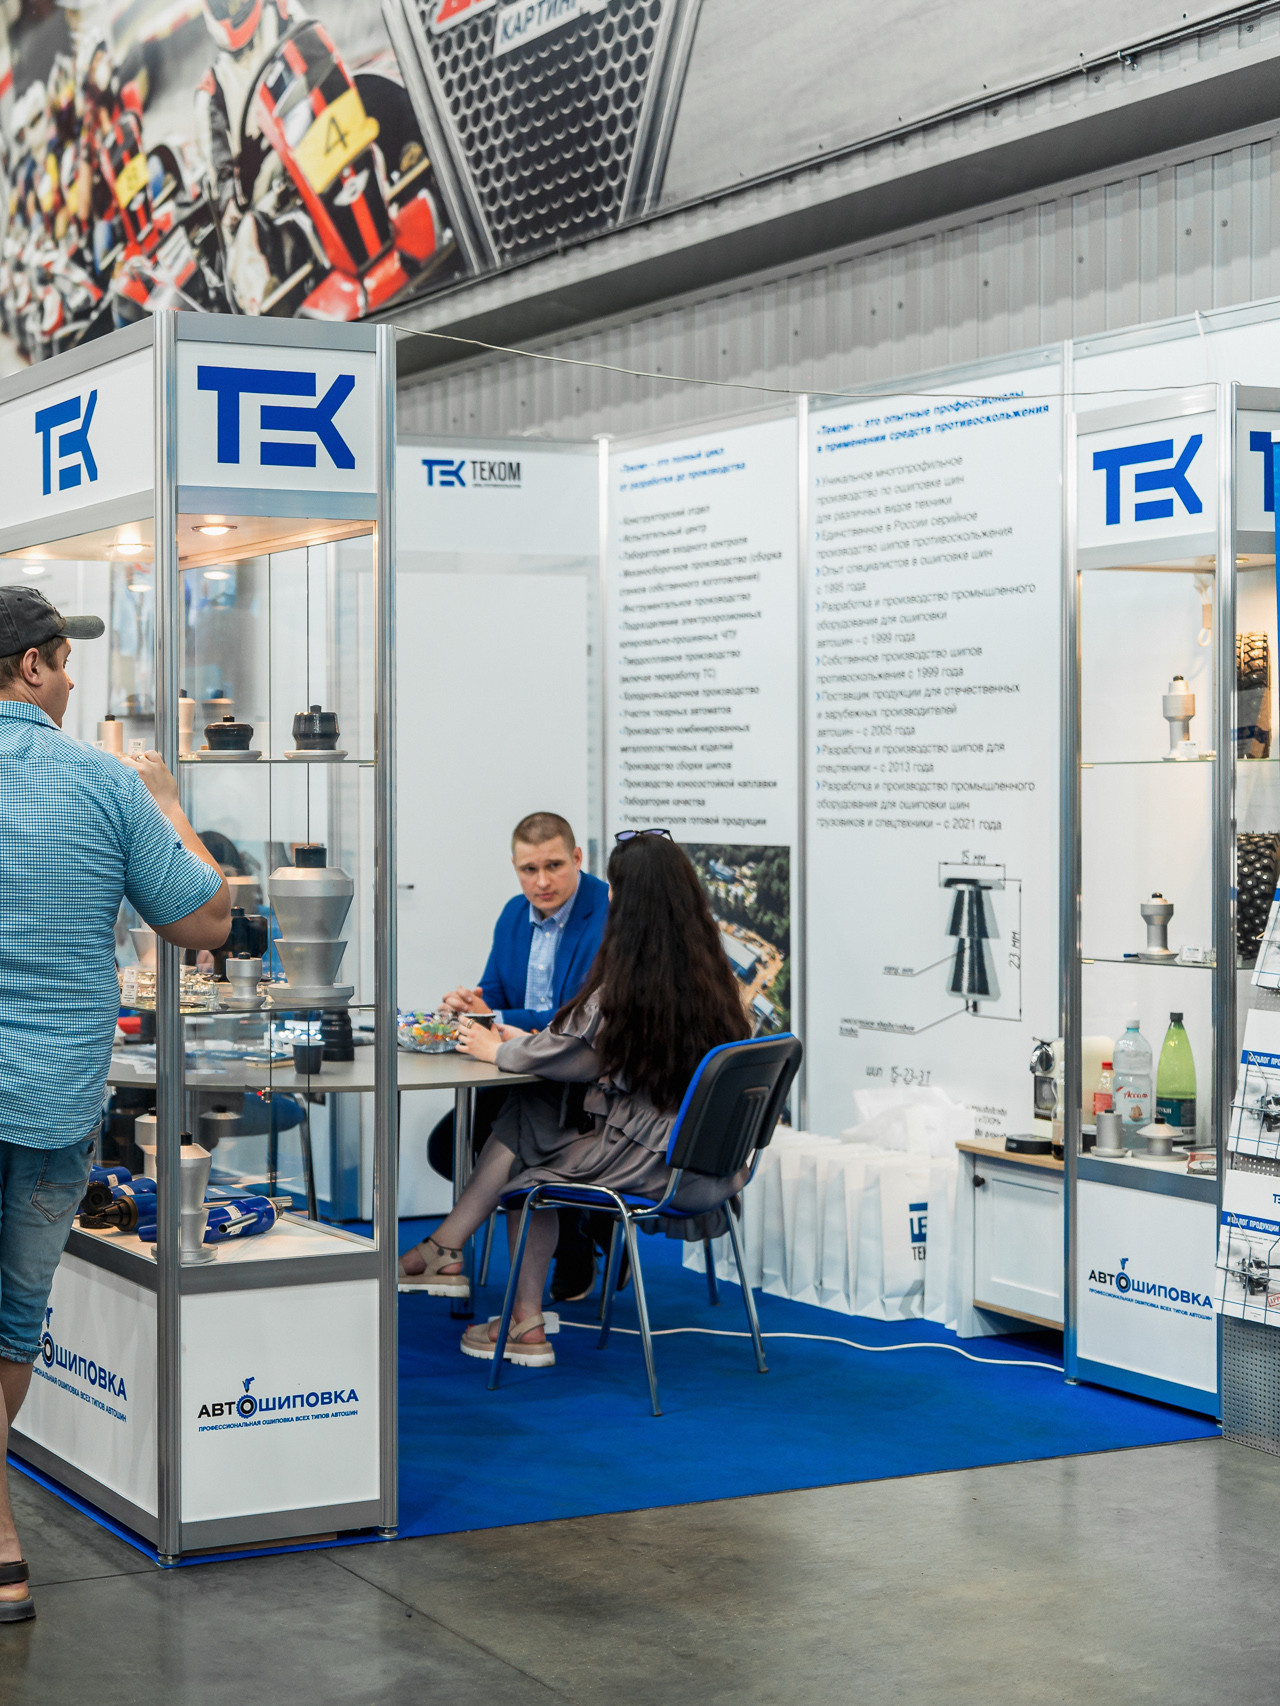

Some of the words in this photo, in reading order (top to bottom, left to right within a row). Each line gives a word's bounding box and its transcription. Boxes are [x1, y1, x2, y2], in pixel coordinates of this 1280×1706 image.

[500, 0, 580, 44] КАРТИН
[324, 115, 349, 157] 4
[471, 460, 521, 481] ТЕКОМ
[1088, 1269, 1213, 1309] АВТОШИПОВКА
[41, 1330, 128, 1402] ОШИПОВКА
[32, 1365, 58, 1386] СИОНАЛЬНАЯ
[57, 1378, 80, 1398] ОШИПОВКА
[80, 1390, 91, 1403] ВСЕХ
[91, 1396, 105, 1412] ТИПОВ
[105, 1404, 127, 1423] АВТОШИН
[197, 1388, 360, 1420] АВТОШИПОВКА
[198, 1420, 261, 1432] ПРОФЕССИОНАЛЬНАЯ
[261, 1416, 295, 1426] ОШИПОВКА
[295, 1414, 310, 1422] ВСЕХ
[311, 1412, 330, 1421] ТИПОВ
[330, 1409, 358, 1419] АВТОШИН
